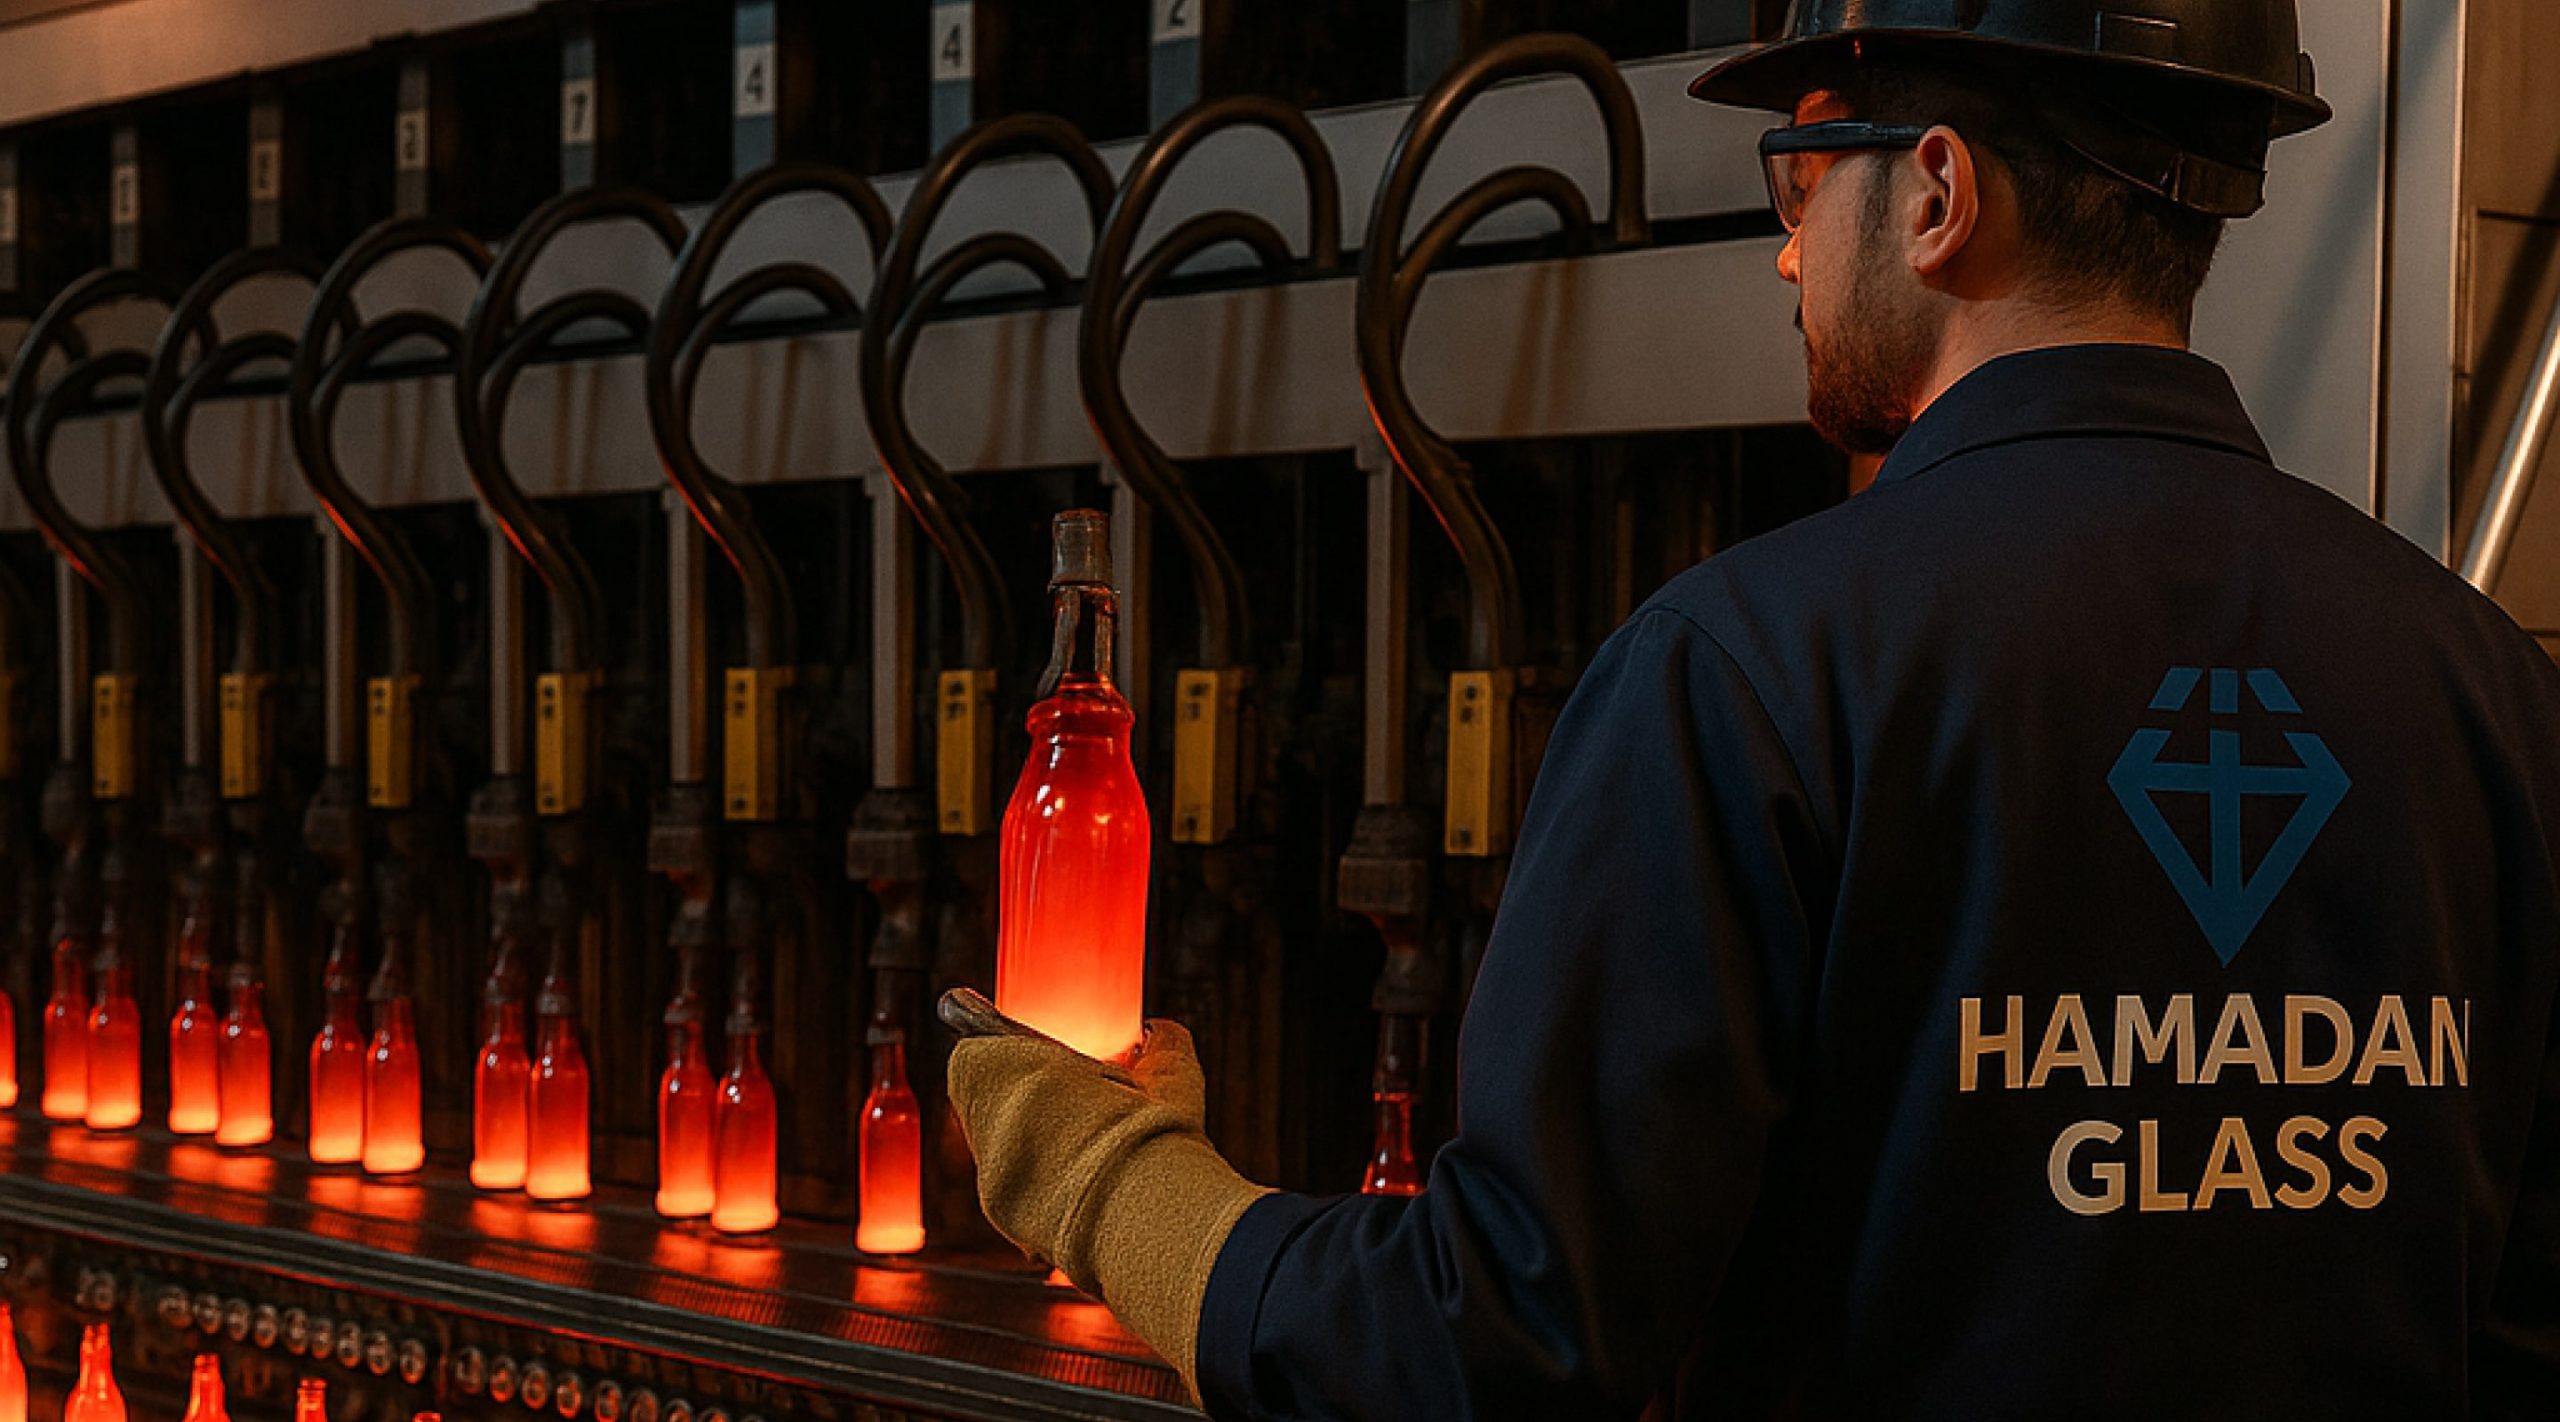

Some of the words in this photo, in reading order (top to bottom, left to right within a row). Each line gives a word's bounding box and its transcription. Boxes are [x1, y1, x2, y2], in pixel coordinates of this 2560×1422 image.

[1168, 0, 1186, 27] 2
[942, 22, 961, 69] 4
[745, 63, 763, 101] 4
[1959, 994, 2470, 1091] HAMADAN
[2048, 1115, 2389, 1216] GLASS
